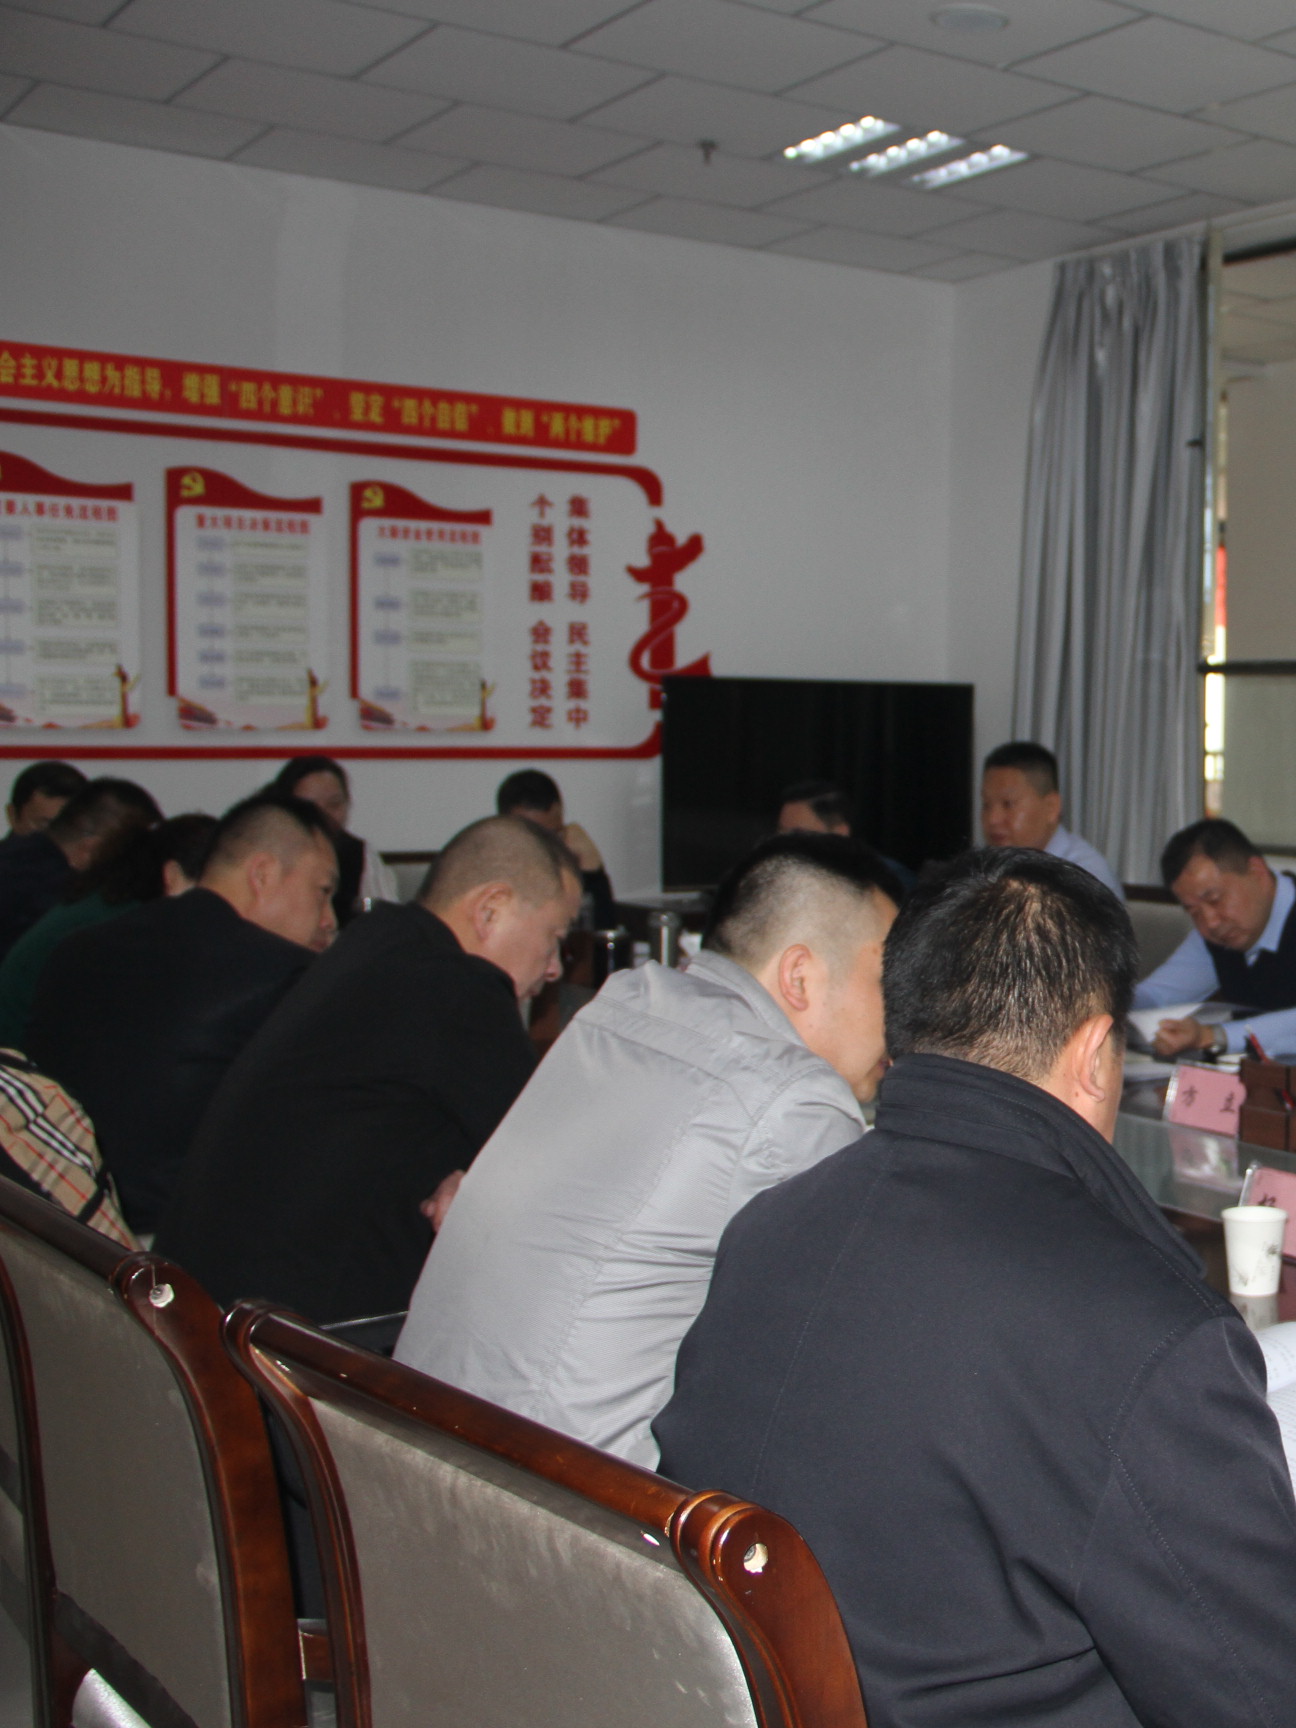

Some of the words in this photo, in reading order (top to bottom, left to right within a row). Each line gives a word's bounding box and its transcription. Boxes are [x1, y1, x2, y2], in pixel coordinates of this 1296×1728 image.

[530, 493, 554, 603] 个别酝酿
[567, 494, 590, 604] 集体领导
[530, 620, 553, 729] 会议决定
[566, 621, 590, 729] 民主集中
